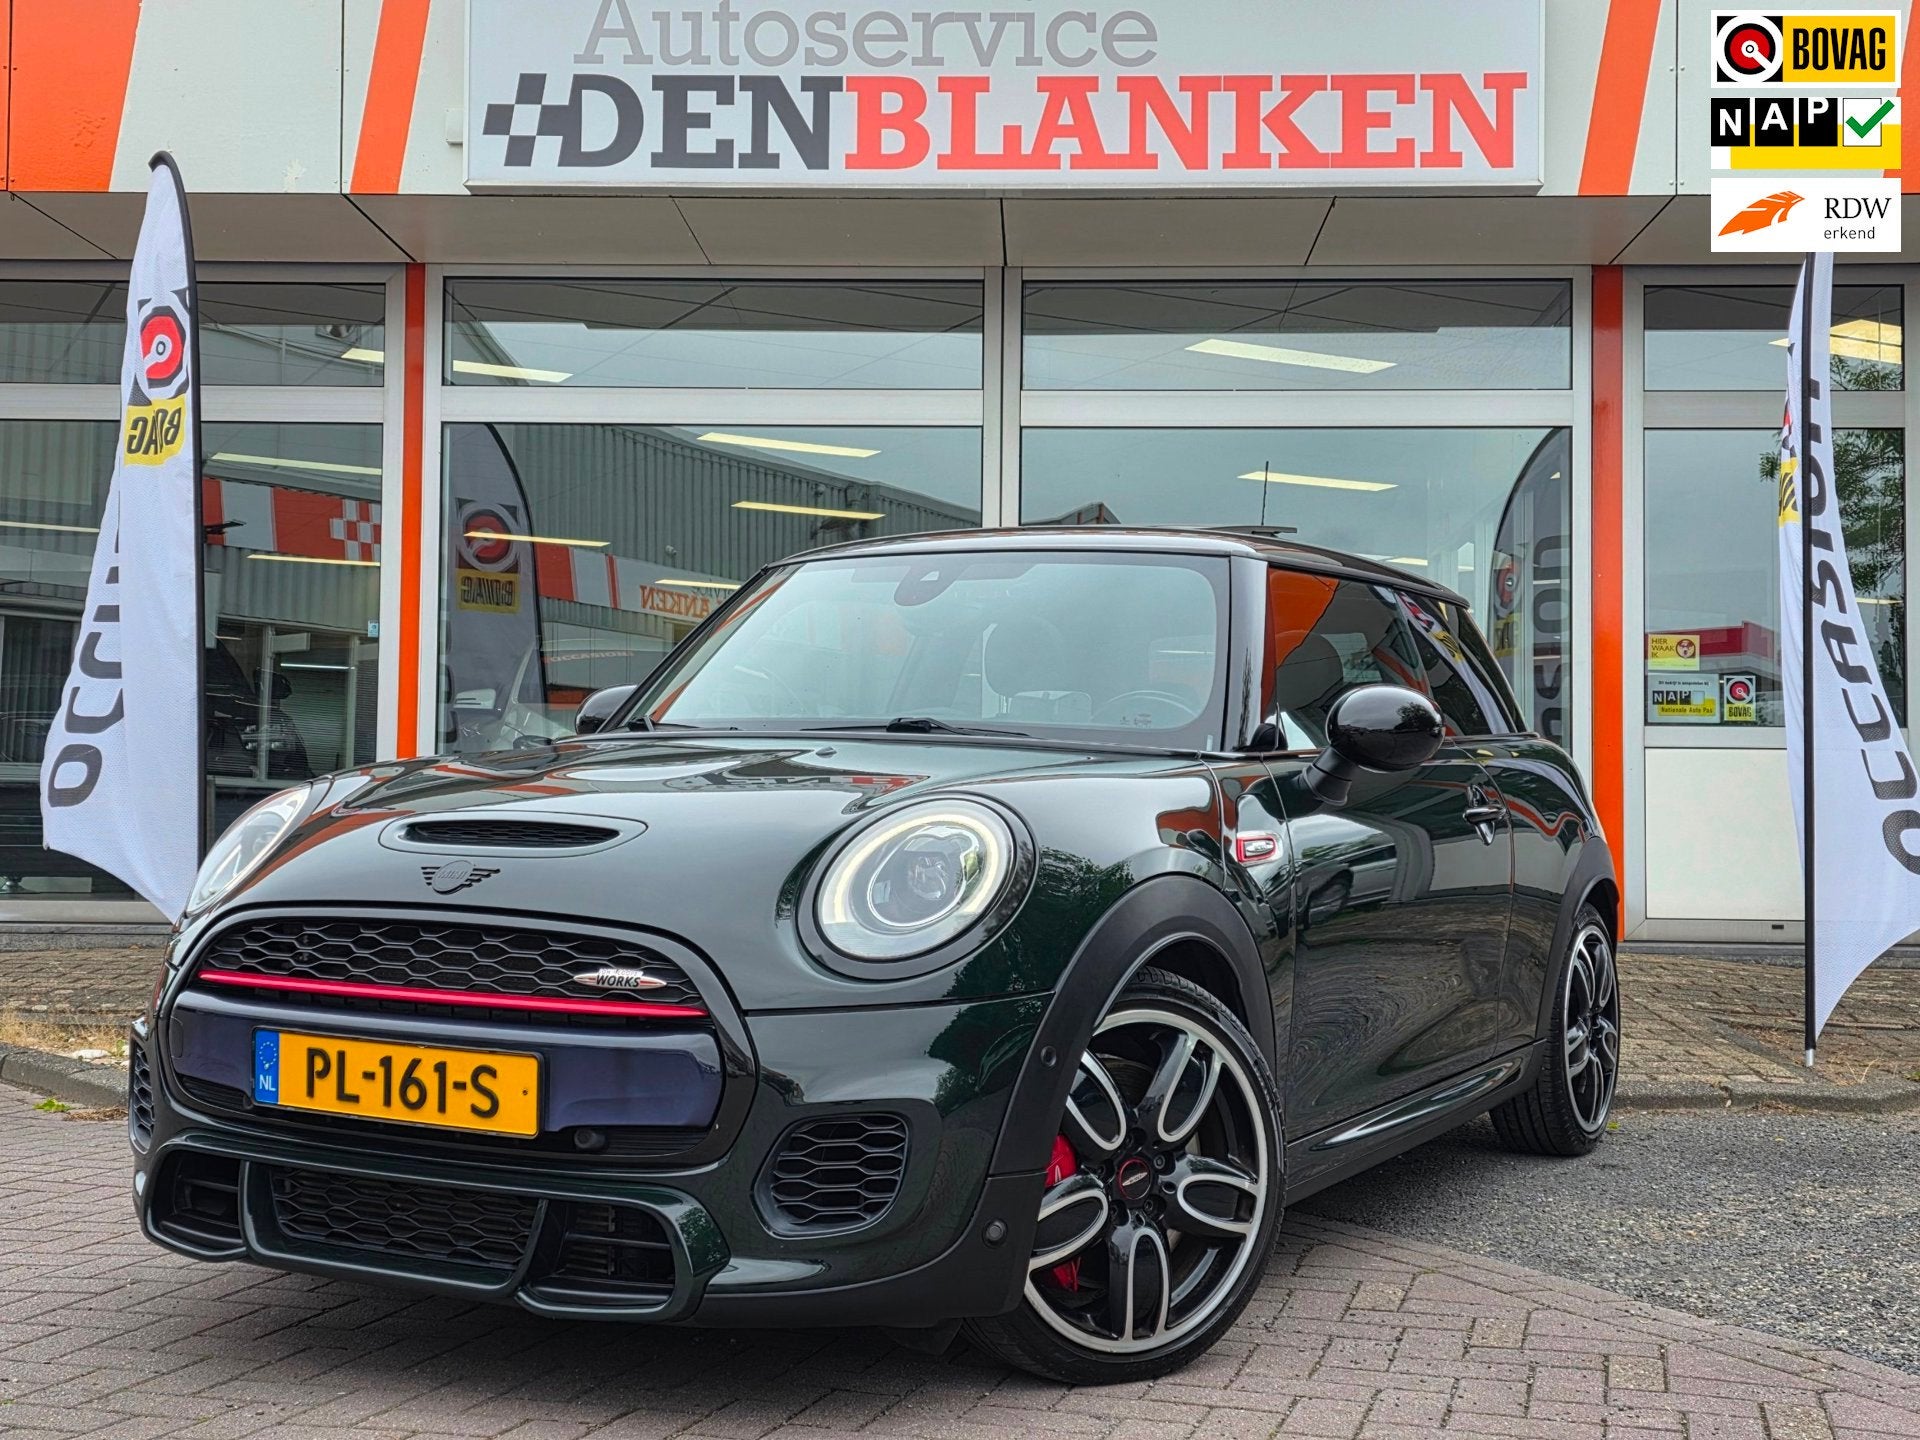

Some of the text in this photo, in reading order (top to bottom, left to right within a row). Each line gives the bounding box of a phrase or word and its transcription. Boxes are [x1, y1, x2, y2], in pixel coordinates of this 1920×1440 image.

[574, 0, 1158, 68] Autoservice
[1806, 378, 1920, 876] OCCASIO
[1653, 691, 1690, 703] NAP
[1728, 706, 1752, 717] BOVAG
[596, 975, 641, 988] WORKS
[259, 1075, 276, 1091] NL
[306, 1047, 500, 1118] PL-161-S
